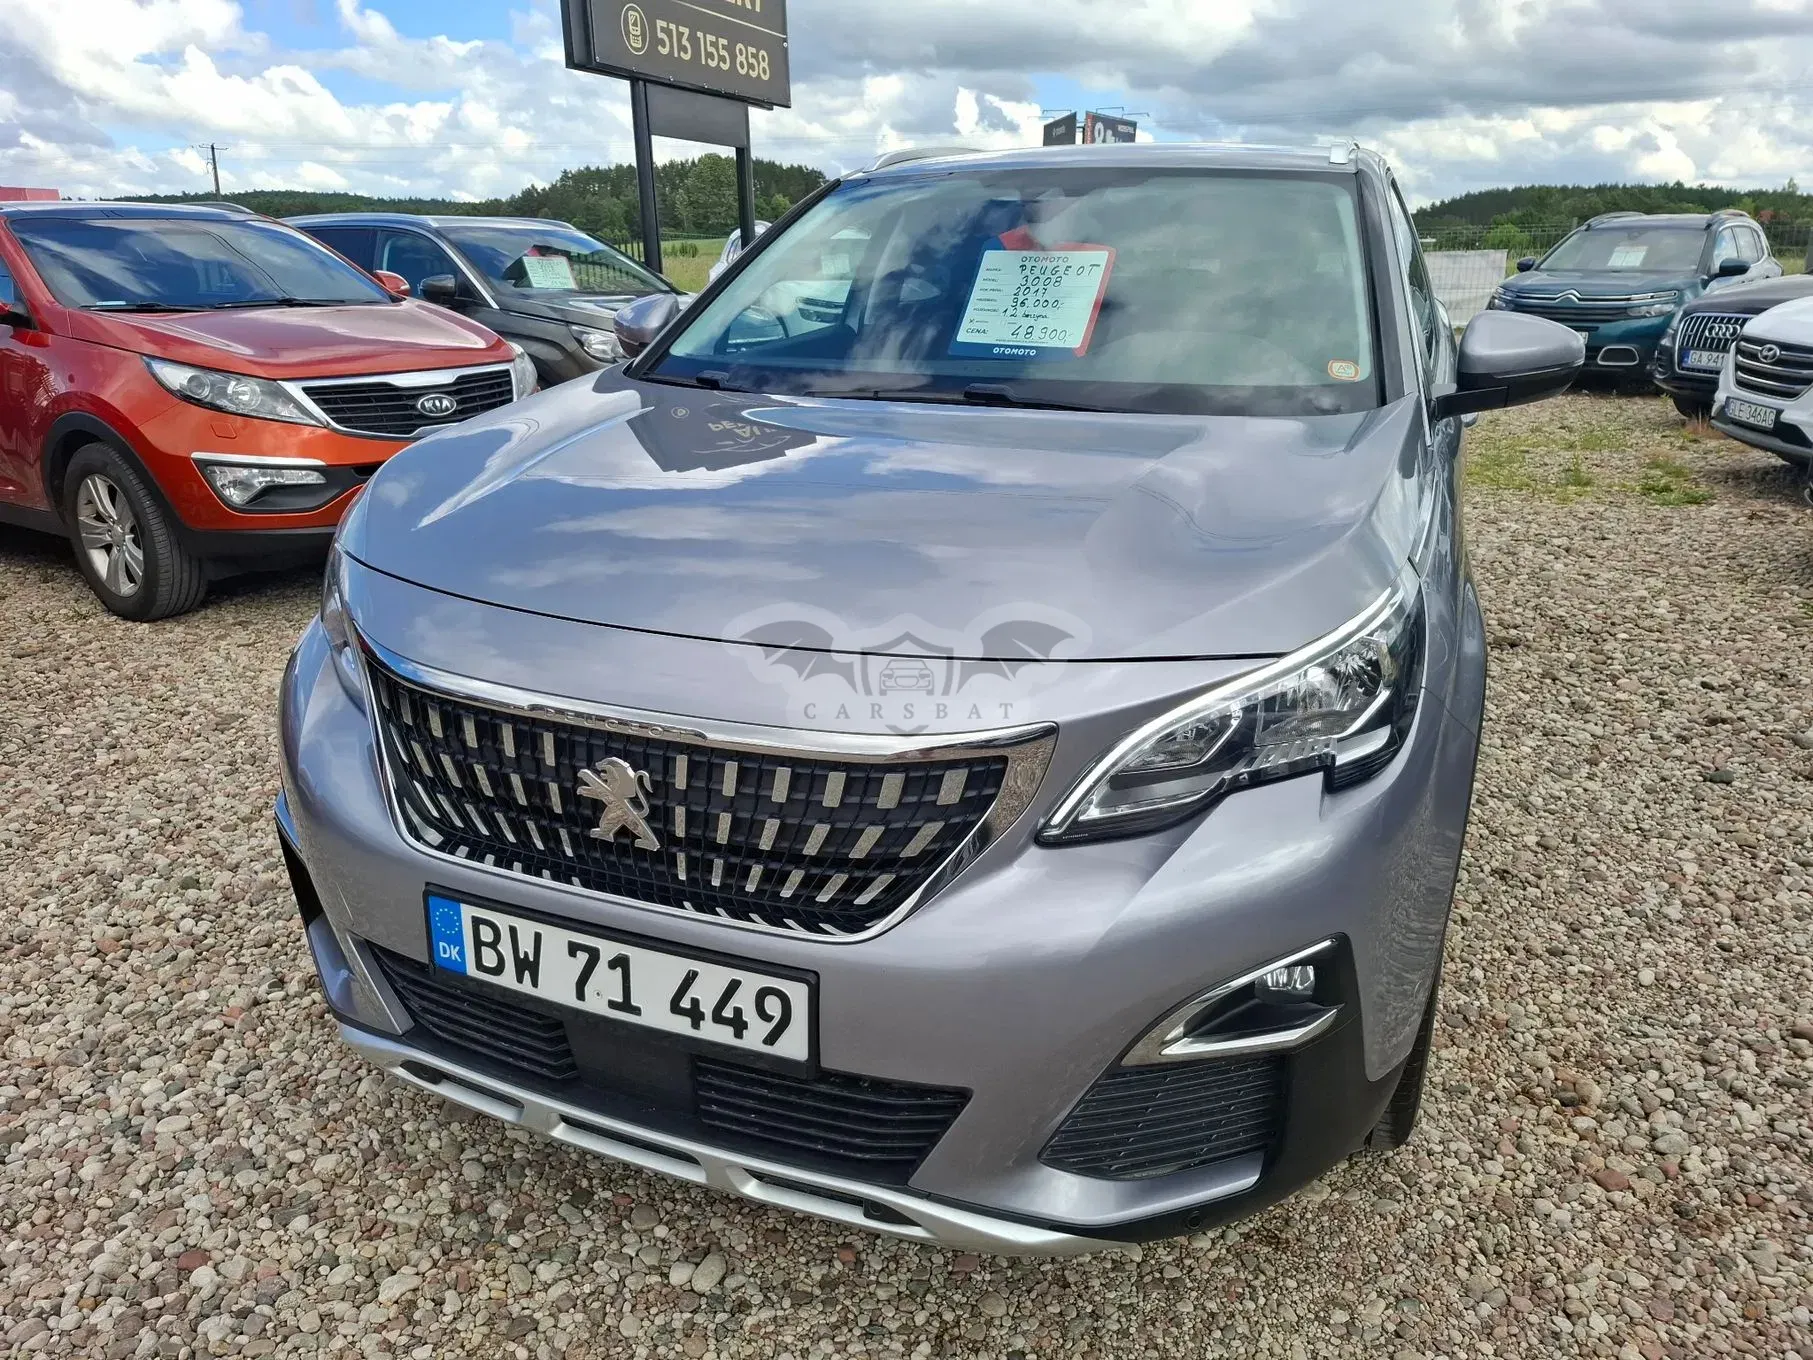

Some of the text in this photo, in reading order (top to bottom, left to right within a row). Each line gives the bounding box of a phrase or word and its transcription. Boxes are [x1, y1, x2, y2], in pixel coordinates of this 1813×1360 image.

[656, 19, 770, 81] 513 155 858
[1019, 264, 1101, 276] PEUGEOT
[1019, 275, 1063, 287] 3008
[1013, 286, 1048, 297] 2017
[965, 327, 989, 335] CENA:
[993, 347, 1037, 356] OTOMOTO
[1690, 352, 1703, 365] GA
[423, 398, 452, 413] KIA
[1745, 403, 1775, 426] 346AG
[544, 706, 689, 741] PEUGEOT
[439, 915, 793, 1047] DK BW 71 449
